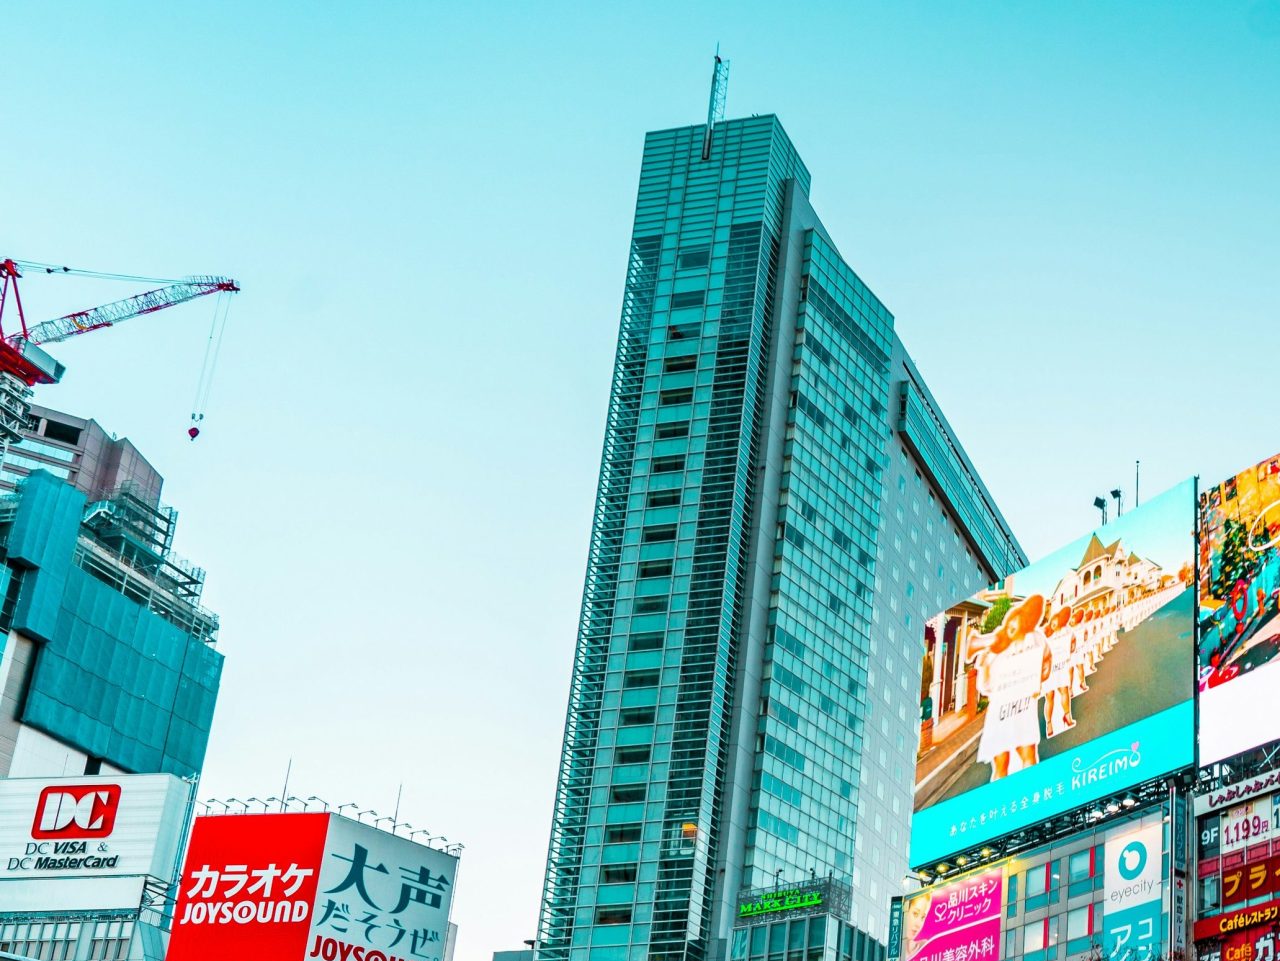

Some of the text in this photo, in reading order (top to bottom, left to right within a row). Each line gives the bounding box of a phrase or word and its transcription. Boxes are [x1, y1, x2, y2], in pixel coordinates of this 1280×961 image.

[25, 841, 108, 855] DC VISA &
[1201, 827, 1218, 846] 9F
[7, 855, 118, 871] DC MasterCard
[186, 863, 314, 899] カラオケ
[323, 843, 451, 915] 大声
[1110, 879, 1154, 903] eyecity
[740, 892, 821, 913] MARK CITY
[947, 878, 998, 908] 品川スキン
[180, 900, 309, 925] JOYSOUND
[948, 898, 992, 925] クリニック
[1226, 943, 1252, 960] Café
